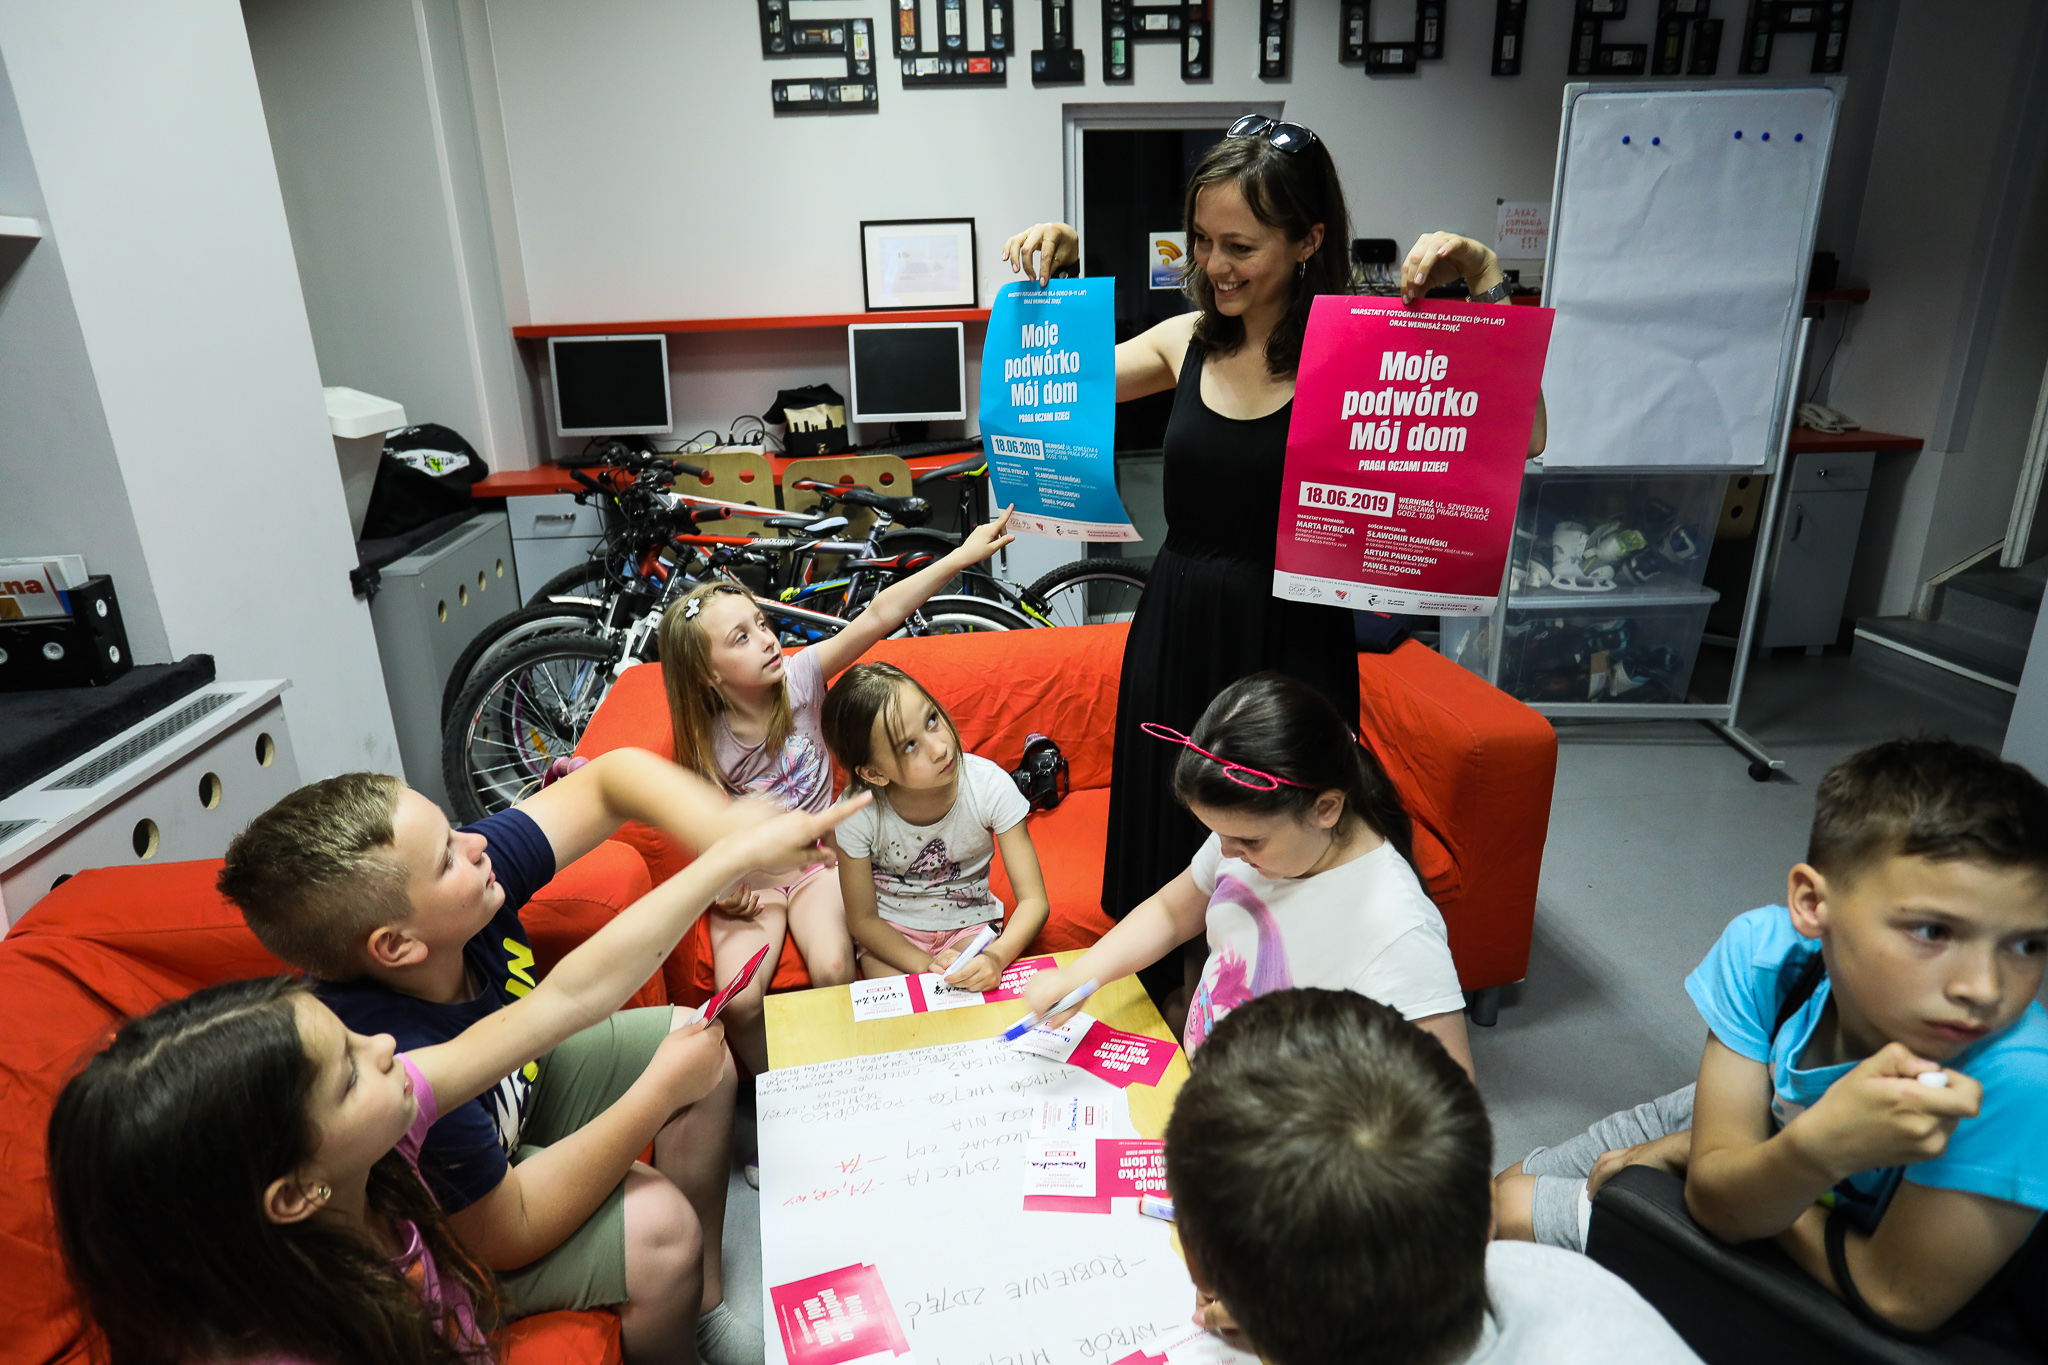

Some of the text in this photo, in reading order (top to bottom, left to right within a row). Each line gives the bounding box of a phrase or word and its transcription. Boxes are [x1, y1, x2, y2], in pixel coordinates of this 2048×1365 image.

[1350, 308, 1506, 327] WARSZTATY FOTOGRAFICZNE DLA DZIECI (9-11 LAT)
[1021, 320, 1058, 349] Moje
[1389, 320, 1461, 333] ORAZ WERNISAŻ ZDJĘĆ
[1005, 349, 1080, 383] podwórko
[1379, 350, 1448, 384] Moje
[1011, 380, 1077, 407] Mój dom
[1341, 384, 1479, 420] podwórko
[1019, 410, 1070, 424] PRAGA OCZAMI DZIECI
[1349, 419, 1468, 453] Mój dom
[995, 438, 1040, 456] 18.06.2019
[997, 466, 1012, 474] MARTA
[1358, 459, 1449, 473] PRAGA OCZAMI DZIECI
[1306, 487, 1388, 512] 18.06.2019
[1399, 497, 1434, 506] WERNISAŻ
[1448, 503, 1484, 513] SZWEDZKA
[1397, 510, 1416, 518] GODZ.
[1398, 504, 1488, 521] WARSZAWA PRAGA PÓŁNOC
[1296, 520, 1355, 535] MARTA RYBICKA
[1367, 531, 1448, 548] SŁAWOMIR KAMIŃSKI
[1364, 549, 1437, 564] ARTUR PAWŁOWSKI
[1363, 561, 1421, 575] PAWEŁ POGODA
[1093, 1049, 1149, 1065] podwórko
[1101, 1042, 1149, 1057] Mój dom
[1102, 1060, 1131, 1072] Moje
[1120, 1157, 1147, 1167] dom
[1135, 1179, 1166, 1191] Moje
[817, 1288, 855, 1342] podwórko
[844, 1294, 867, 1322] Moje
[803, 1297, 835, 1346] Mój dom
